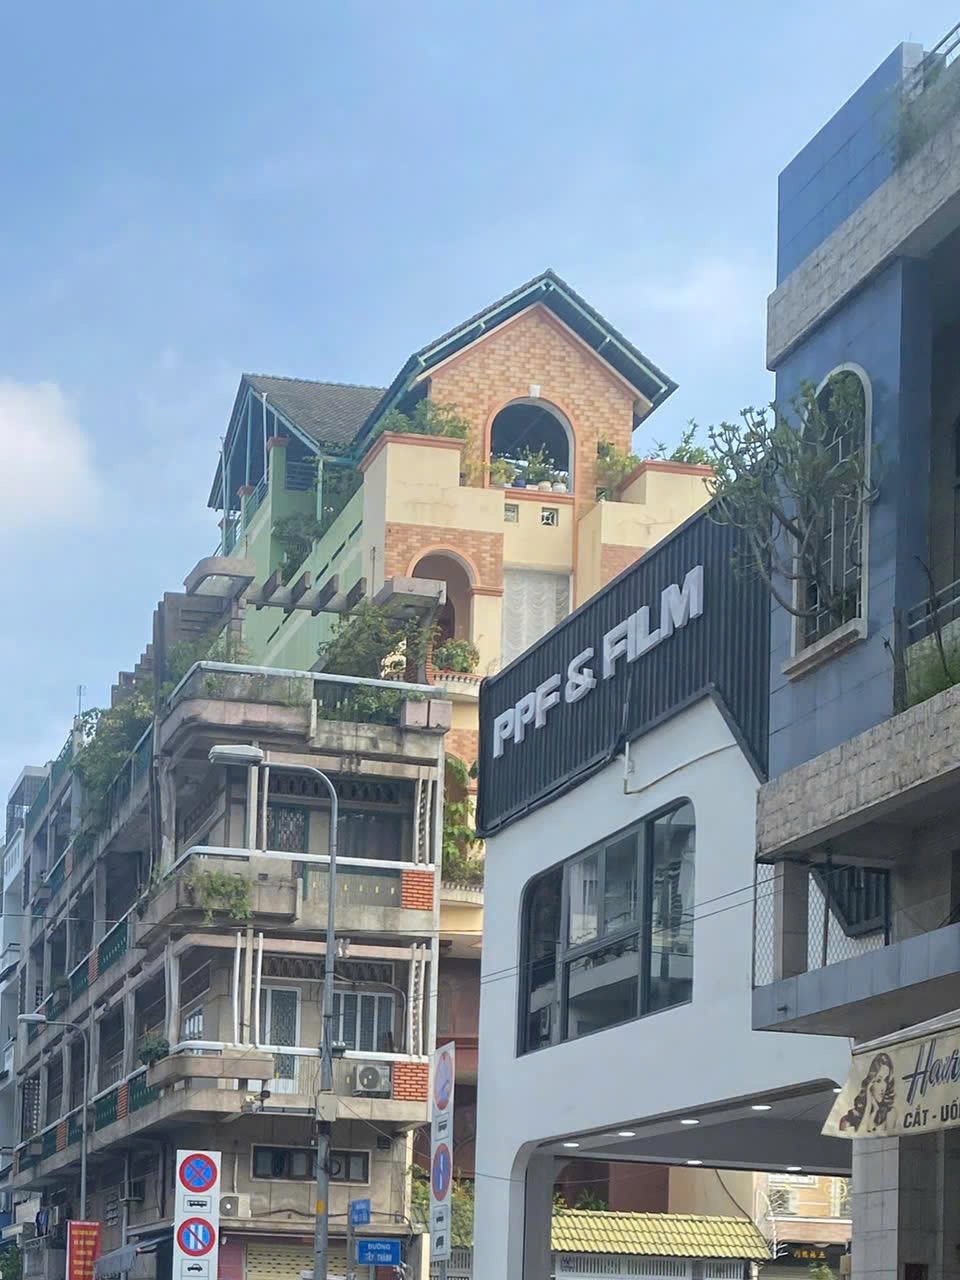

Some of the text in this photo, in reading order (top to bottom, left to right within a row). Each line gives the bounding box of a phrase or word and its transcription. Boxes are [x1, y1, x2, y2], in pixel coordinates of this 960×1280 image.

[493, 565, 704, 759] PPF & FILM
[903, 1105, 929, 1128] CẮT
[940, 1097, 960, 1122] UỐ
